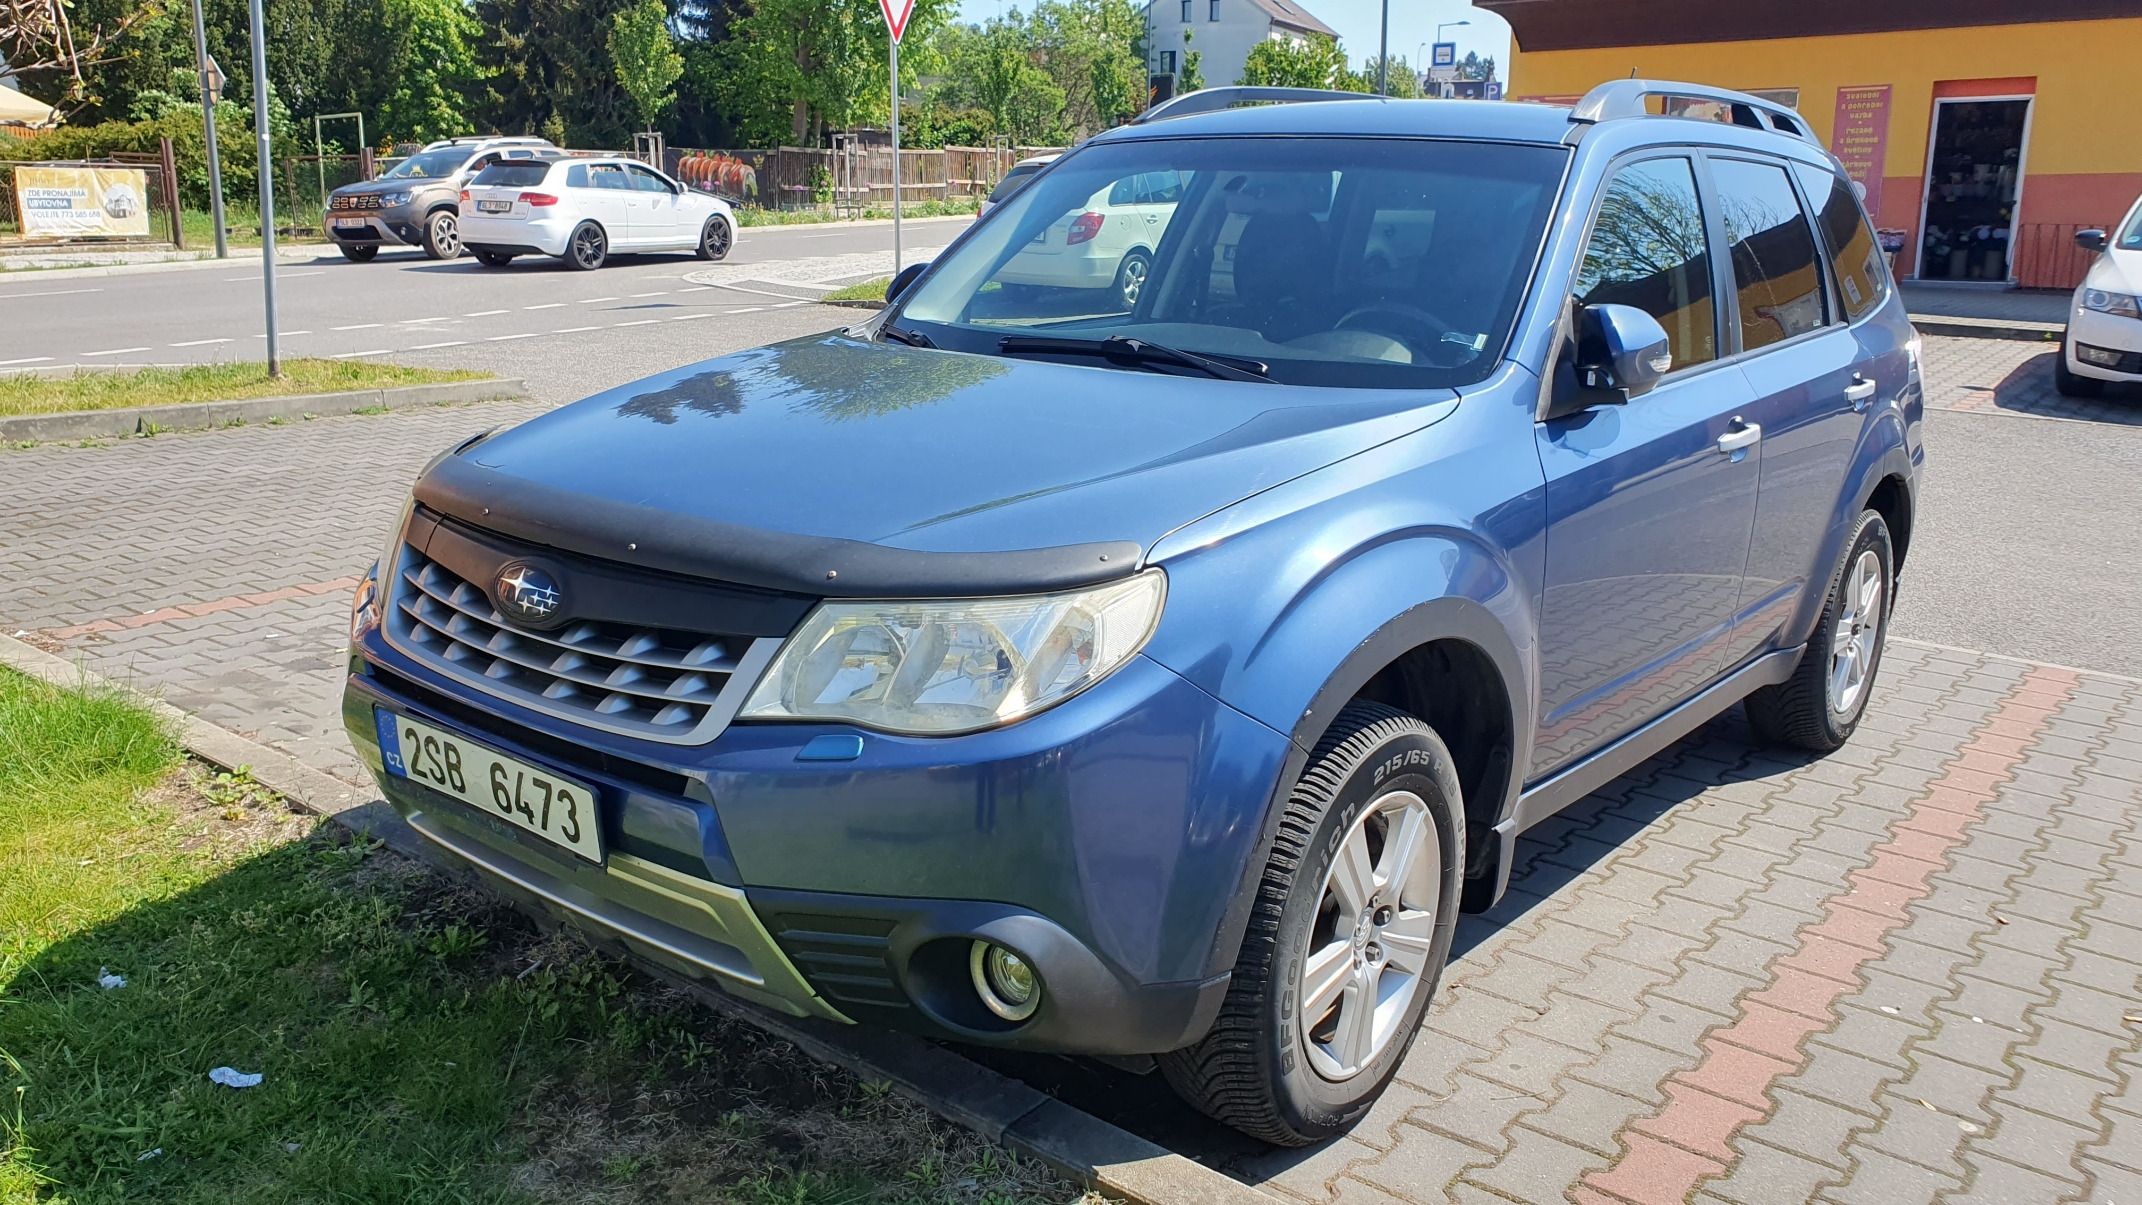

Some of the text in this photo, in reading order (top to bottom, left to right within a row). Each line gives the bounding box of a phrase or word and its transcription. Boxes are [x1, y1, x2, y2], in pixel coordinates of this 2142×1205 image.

[1488, 85, 1498, 100] P
[28, 189, 40, 197] ZDE
[28, 199, 69, 207] UBYTOVNA
[31, 210, 59, 218] VOLEJTE
[386, 751, 403, 768] CZ
[1374, 749, 1431, 786] 215/65
[404, 727, 581, 844] 2SB 6473
